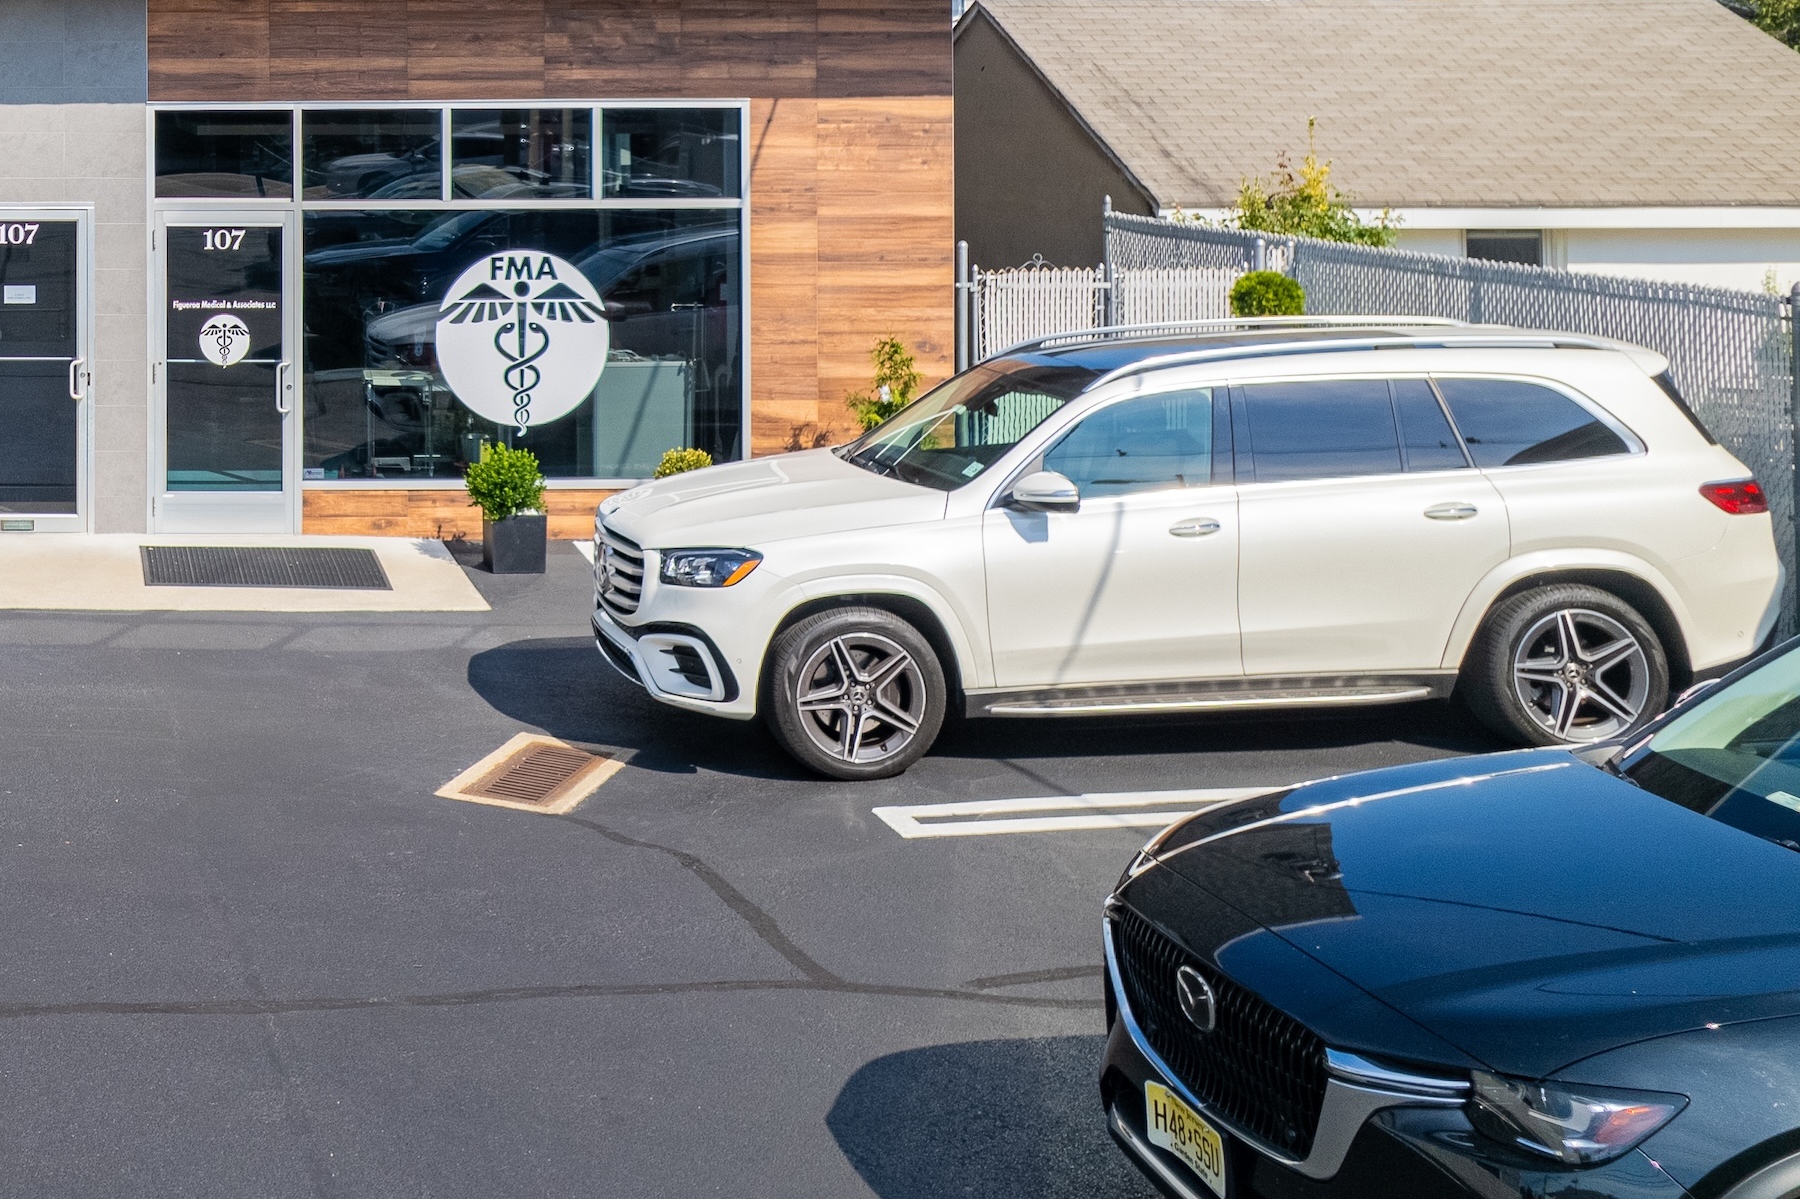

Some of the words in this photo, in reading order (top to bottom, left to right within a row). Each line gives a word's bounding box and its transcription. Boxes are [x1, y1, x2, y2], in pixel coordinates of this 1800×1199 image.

[202, 229, 246, 251] 107
[490, 256, 559, 281] FMA
[172, 300, 200, 310] Figueroa
[201, 299, 225, 309] Medical
[226, 300, 231, 309] &
[233, 299, 265, 309] Associates
